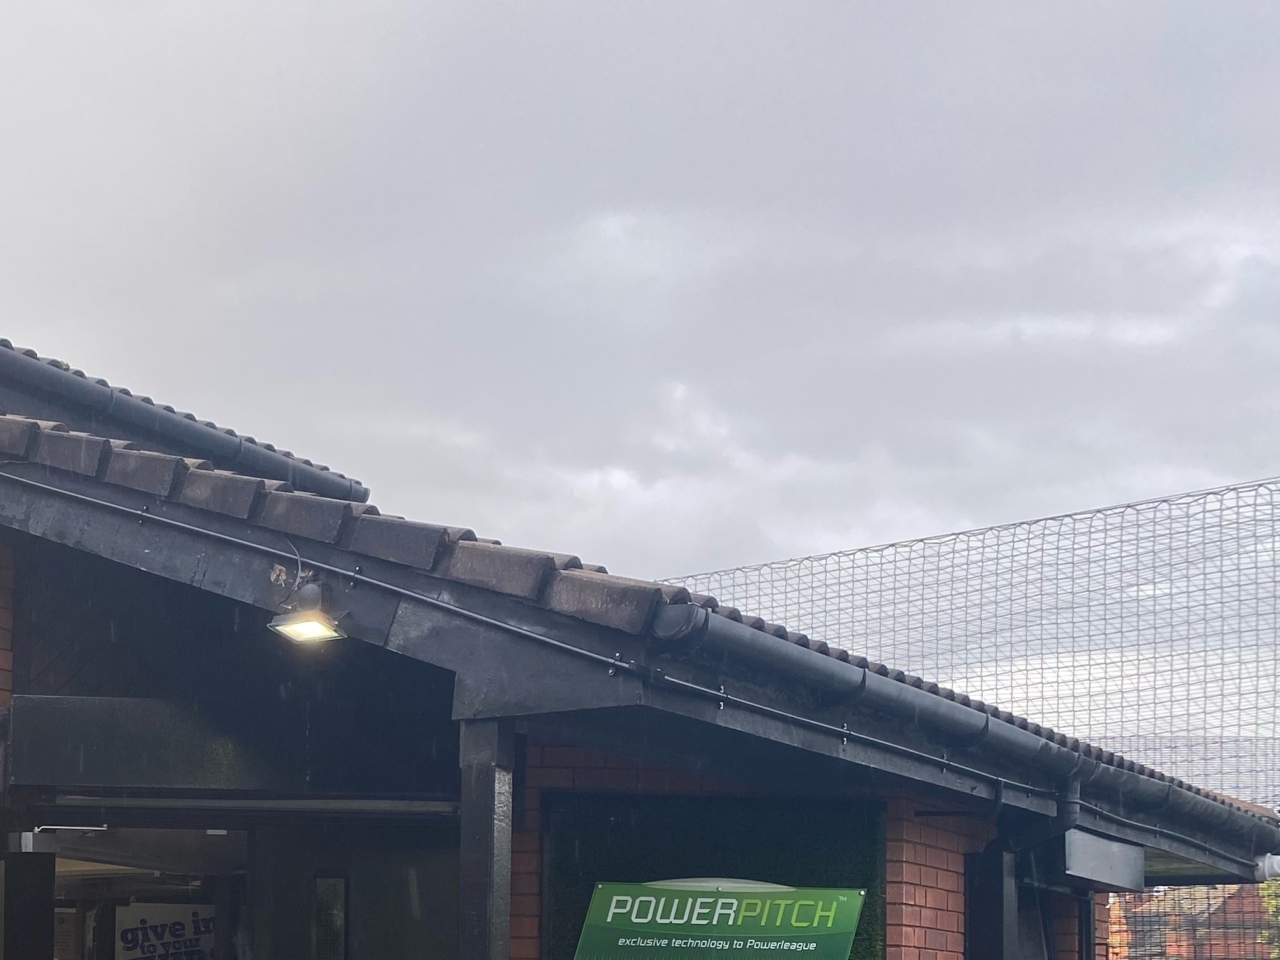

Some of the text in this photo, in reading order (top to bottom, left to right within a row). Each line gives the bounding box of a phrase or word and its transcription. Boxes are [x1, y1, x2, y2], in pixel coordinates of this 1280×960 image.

[121, 918, 186, 951] give
[618, 936, 817, 951] exclusive technology to Powerleague
[140, 937, 202, 955] to your
